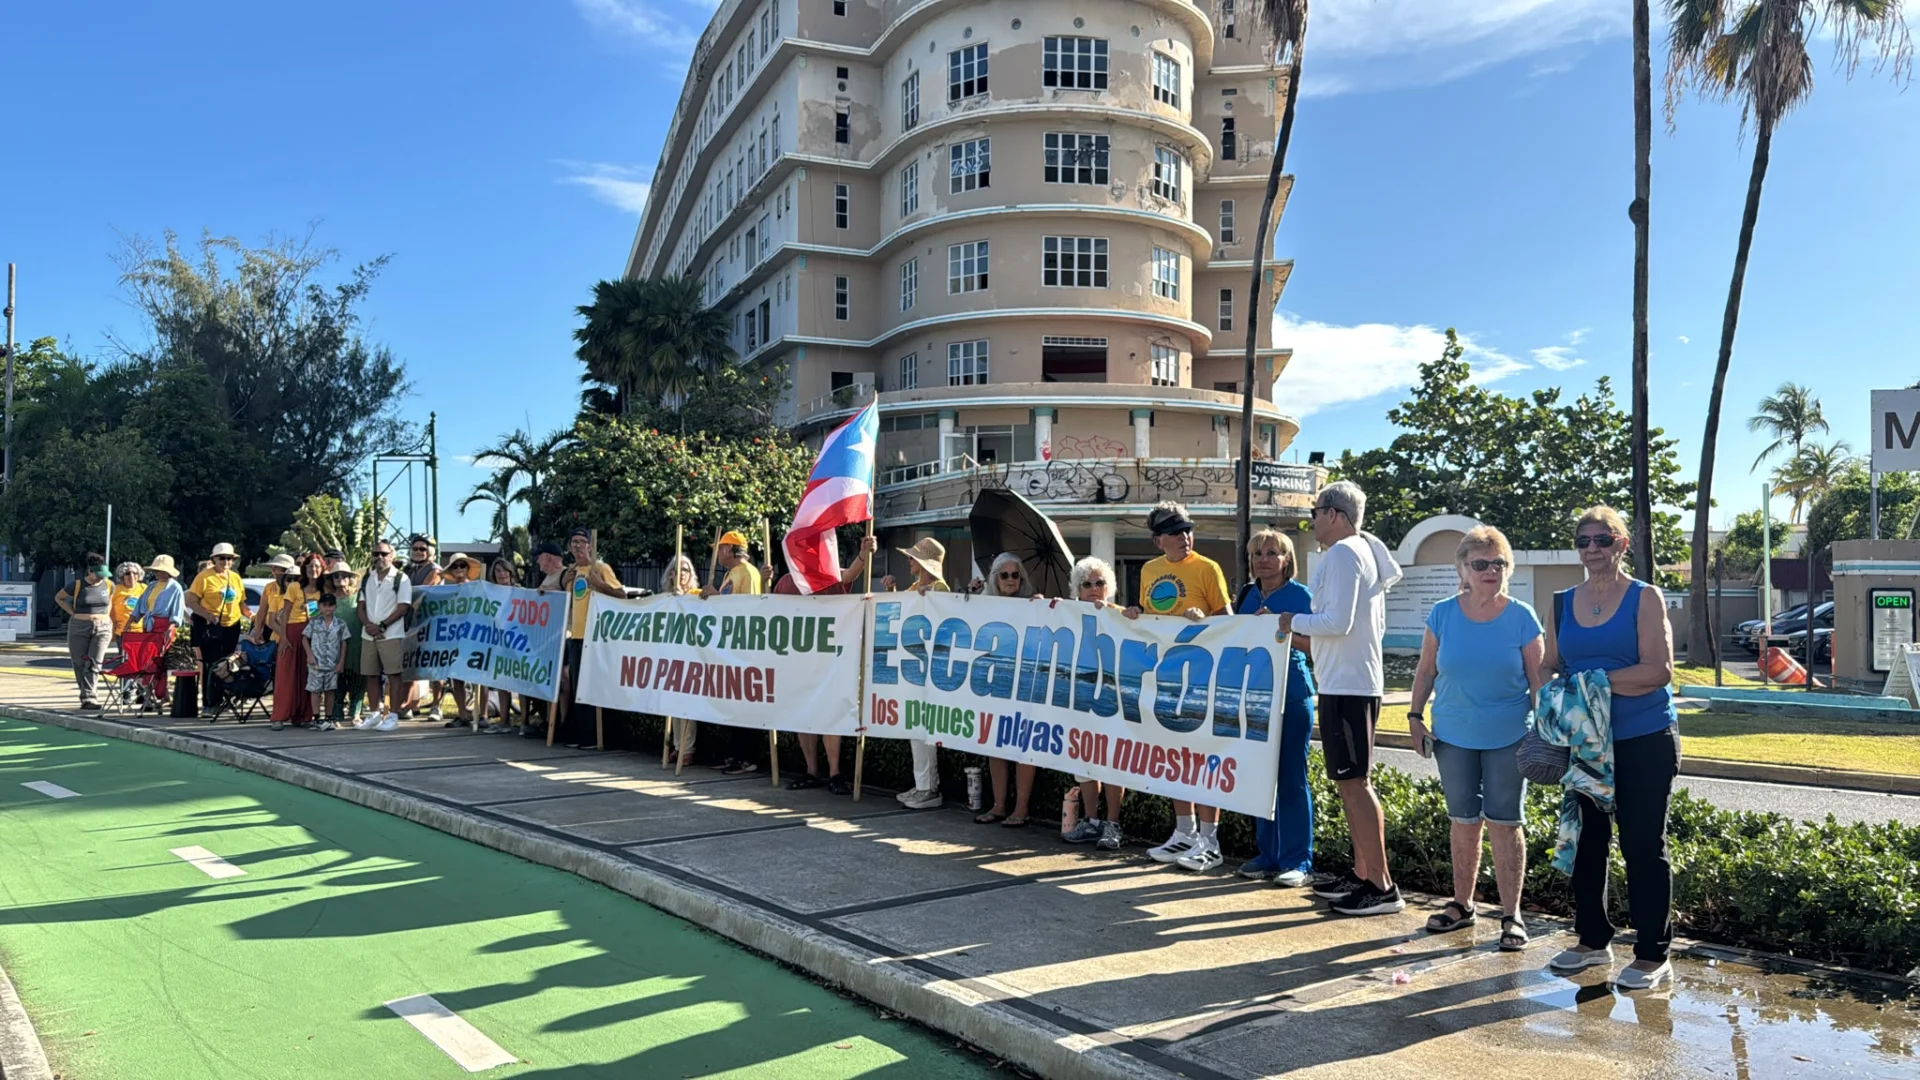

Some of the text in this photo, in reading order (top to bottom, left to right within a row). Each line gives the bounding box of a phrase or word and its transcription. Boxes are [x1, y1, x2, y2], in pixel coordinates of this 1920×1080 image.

[1250, 475, 1311, 492] PARKING
[1255, 465, 1308, 477] NORMANDIE
[507, 598, 549, 627] TODO
[1877, 597, 1908, 606] OPEN
[417, 620, 430, 642] el
[592, 610, 844, 658] ¡QUEREMOS PARQUE,
[467, 648, 491, 671] al
[493, 654, 553, 686] pueblo!
[620, 655, 775, 703] NO PARKING!
[872, 601, 1274, 742] Escambrón
[871, 693, 899, 726] los
[977, 711, 994, 745] y
[995, 711, 1064, 756] playas
[1068, 727, 1109, 767] son
[1112, 737, 1237, 794] nuestros
